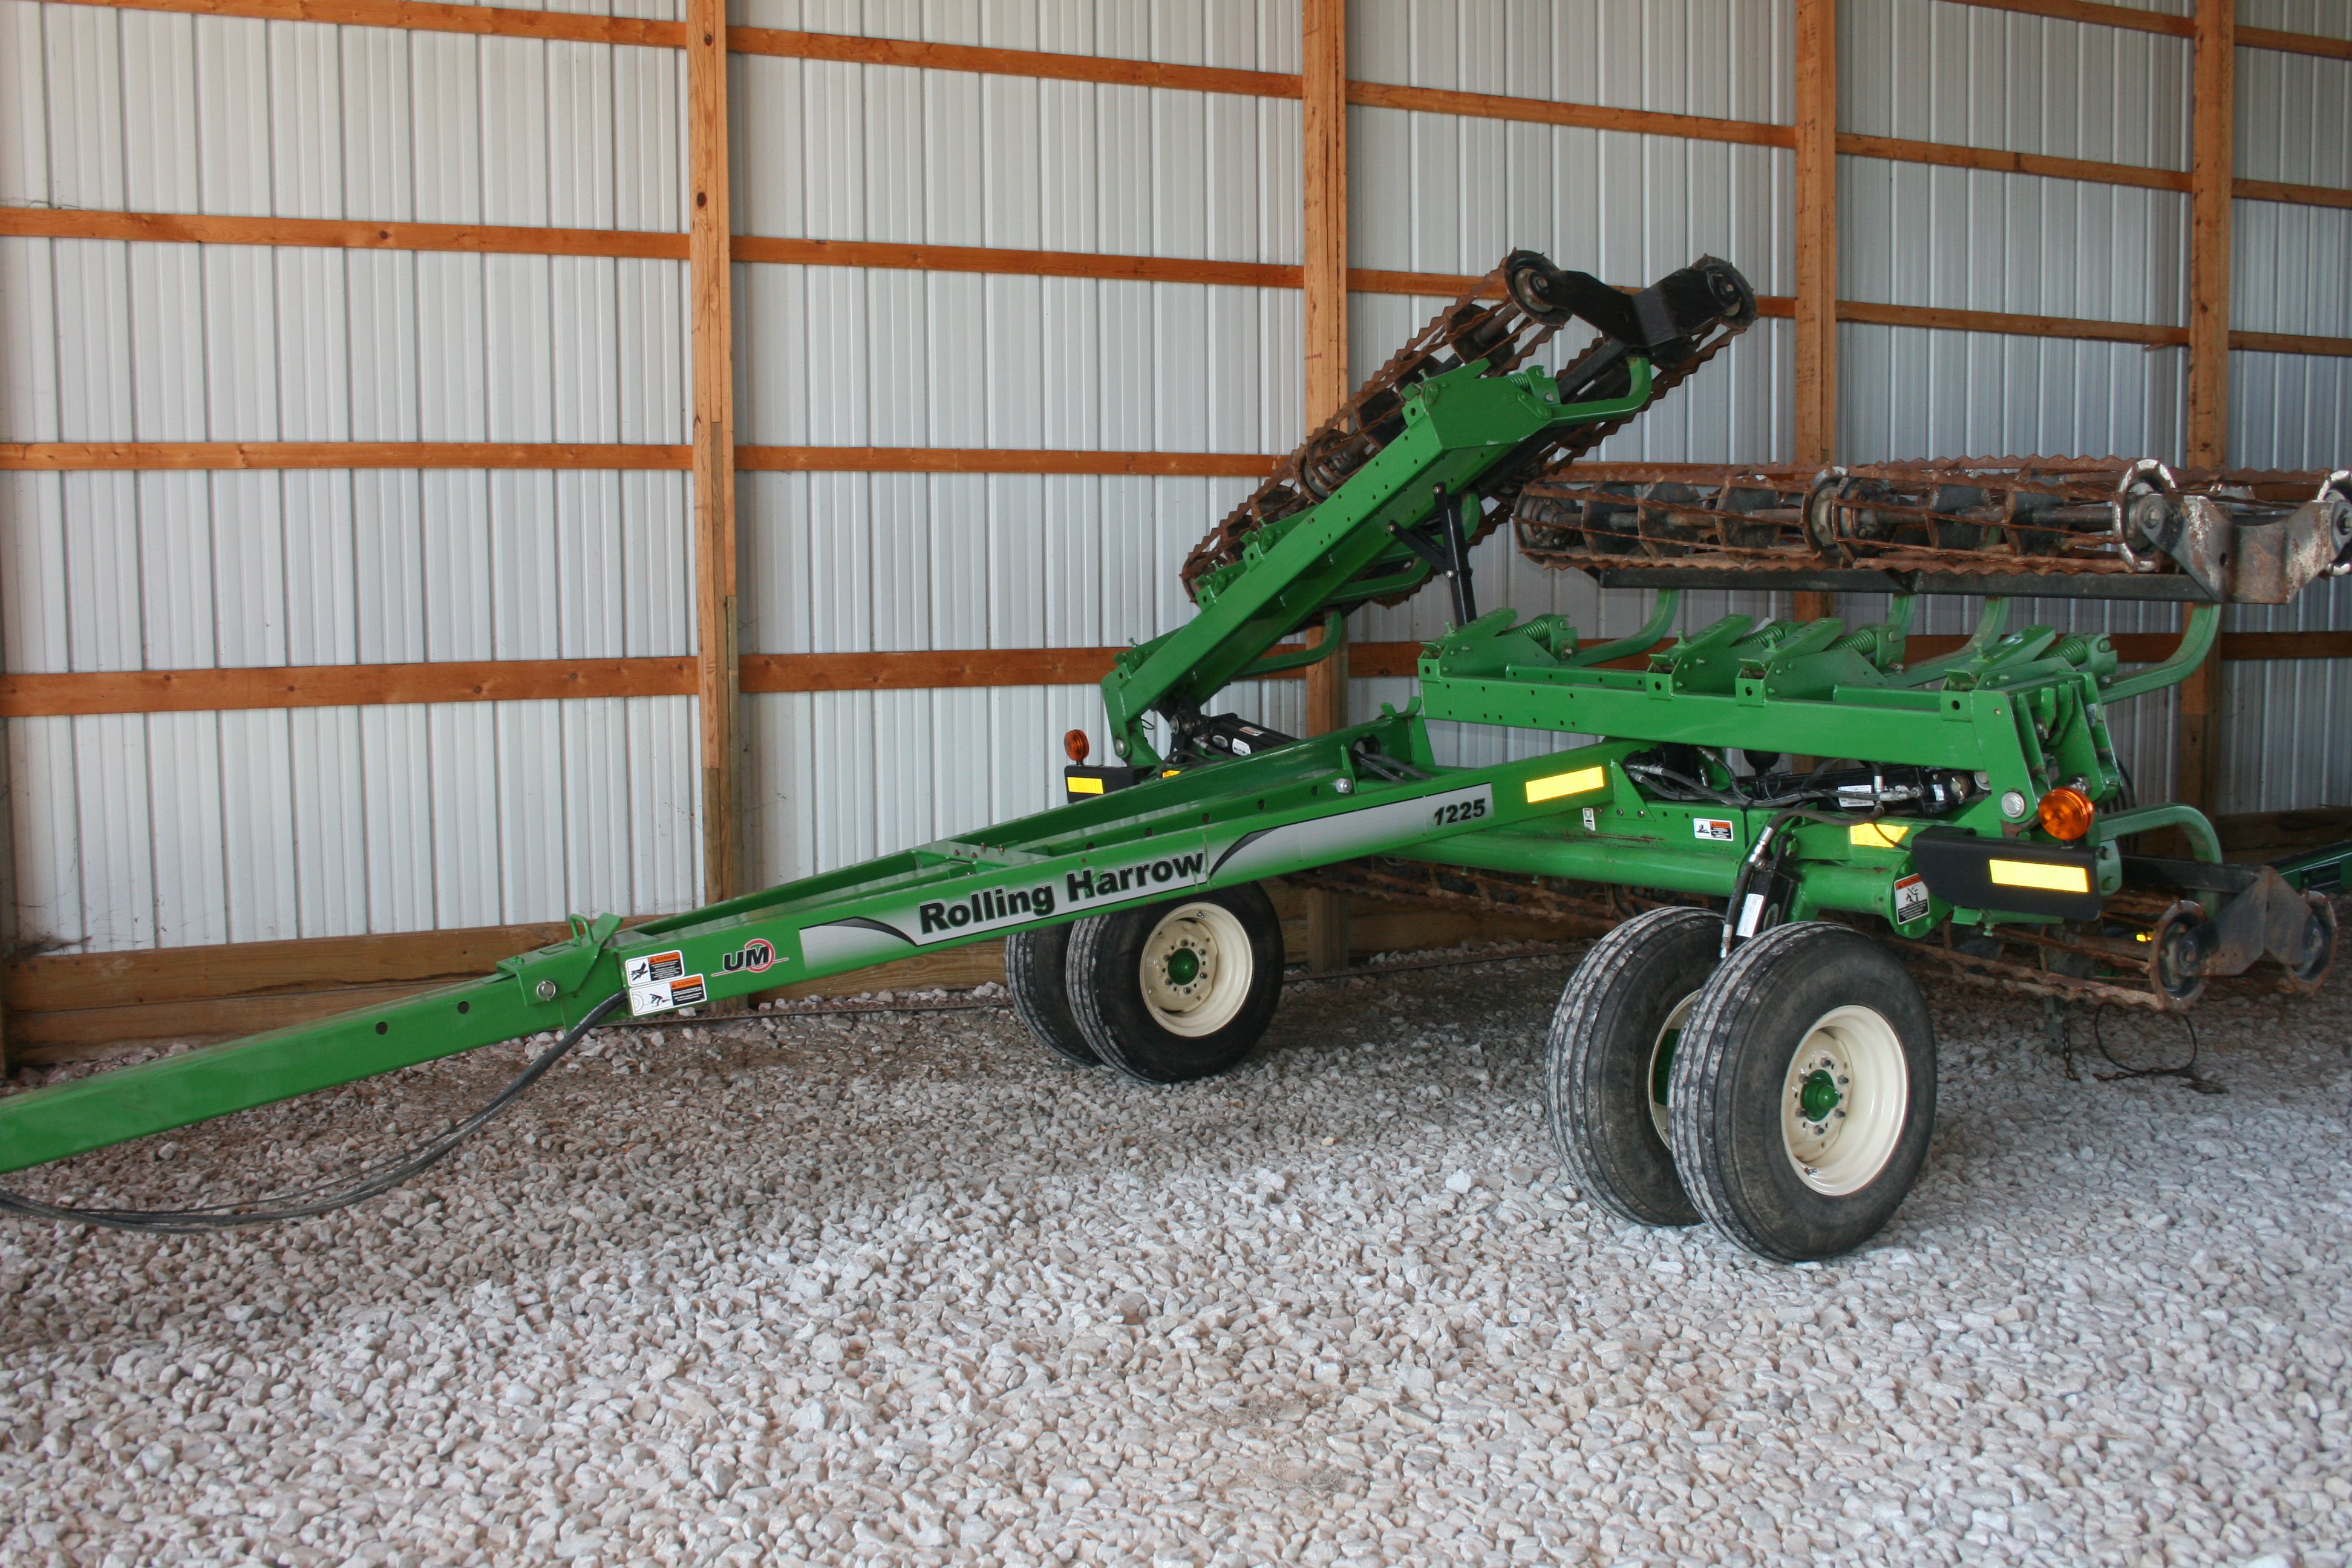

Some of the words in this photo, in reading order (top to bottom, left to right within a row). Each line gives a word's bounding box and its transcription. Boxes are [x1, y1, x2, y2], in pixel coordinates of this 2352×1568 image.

[1434, 798, 1486, 826] 1225
[919, 884, 1055, 934] Rolling
[1065, 852, 1203, 902] Harrow
[724, 946, 769, 971] UM
